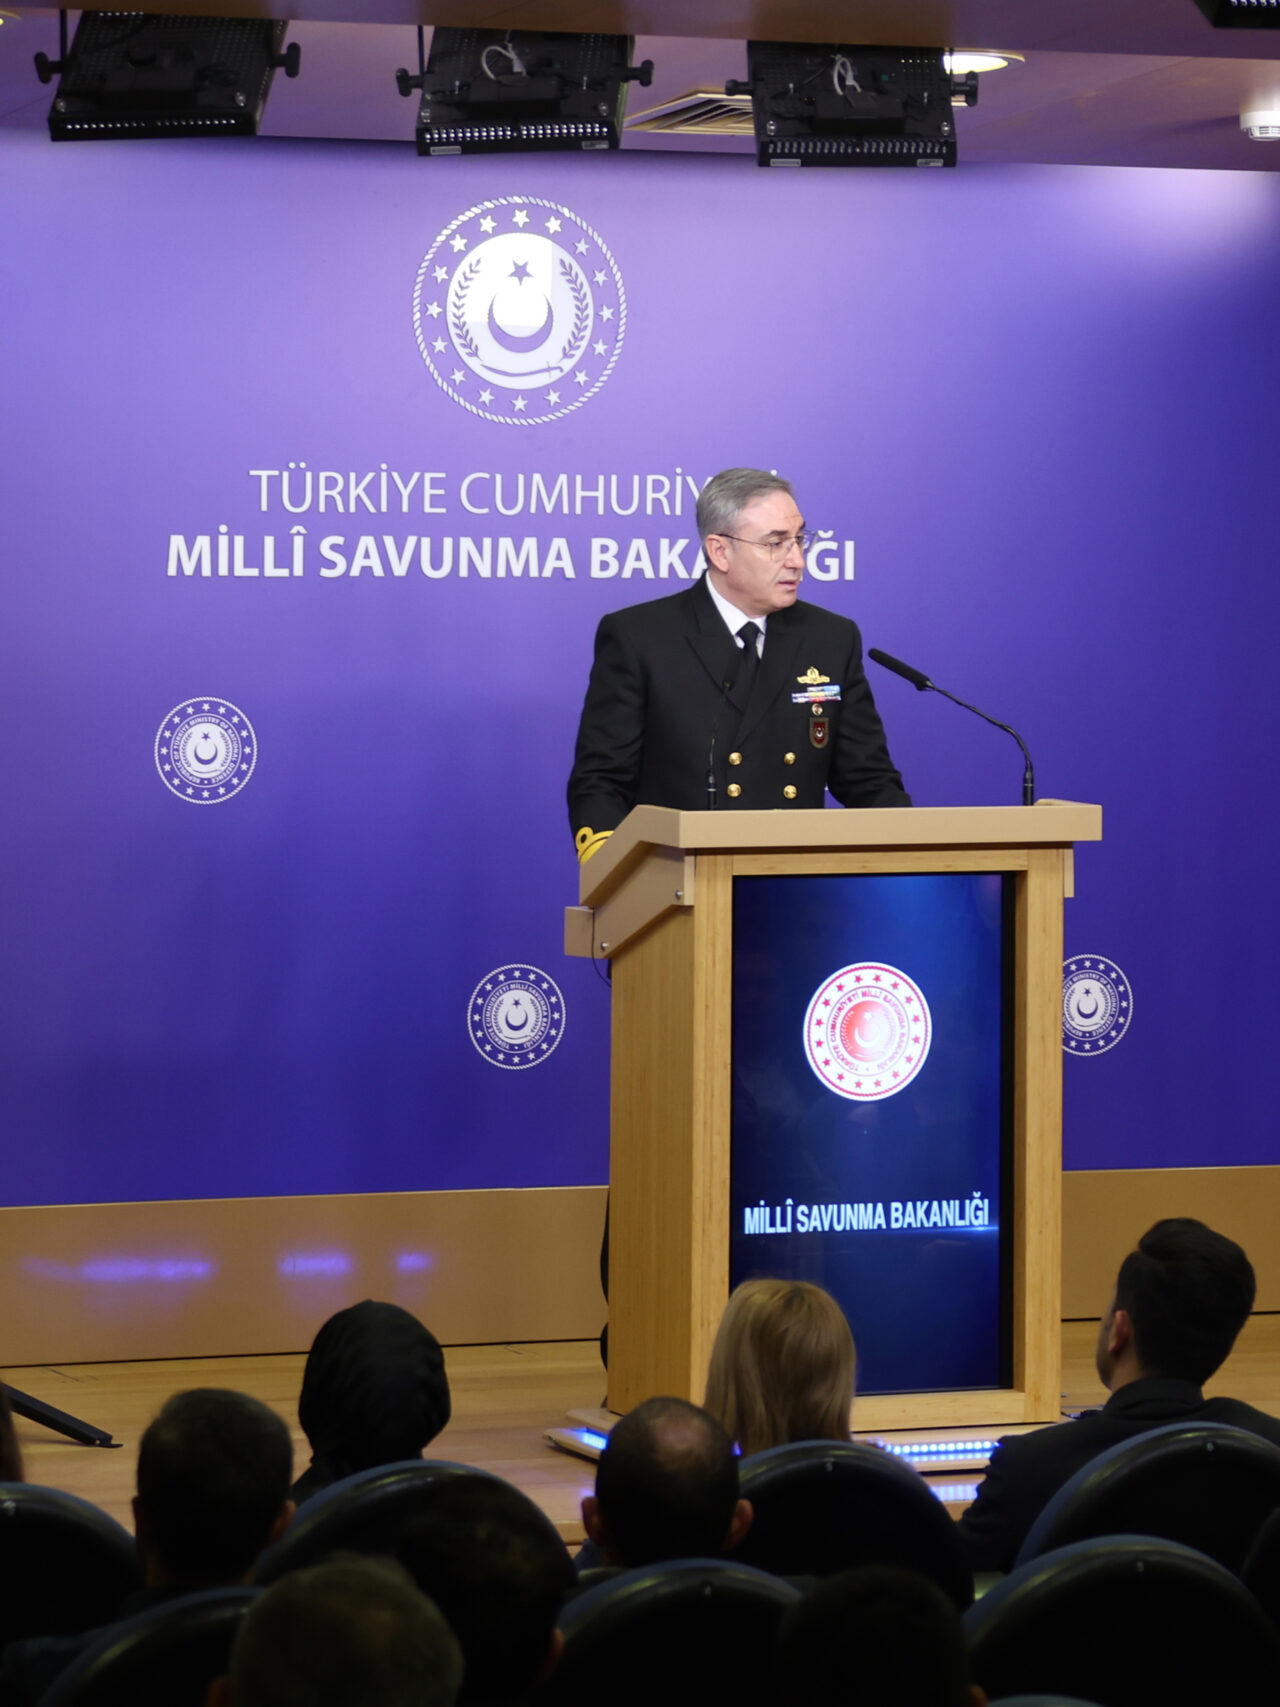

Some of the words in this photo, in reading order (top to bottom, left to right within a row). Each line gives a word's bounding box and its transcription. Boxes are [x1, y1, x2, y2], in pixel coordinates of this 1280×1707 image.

[249, 462, 447, 514] TÜRKİYE
[459, 463, 777, 516] CUMHURİY
[166, 524, 309, 578] MİLLÎ
[318, 535, 576, 580] SAVUNMA
[744, 1198, 793, 1234] MİLLÎ
[796, 1202, 886, 1232] SAVUNMA
[890, 1191, 989, 1228] BAKANLIĞI
